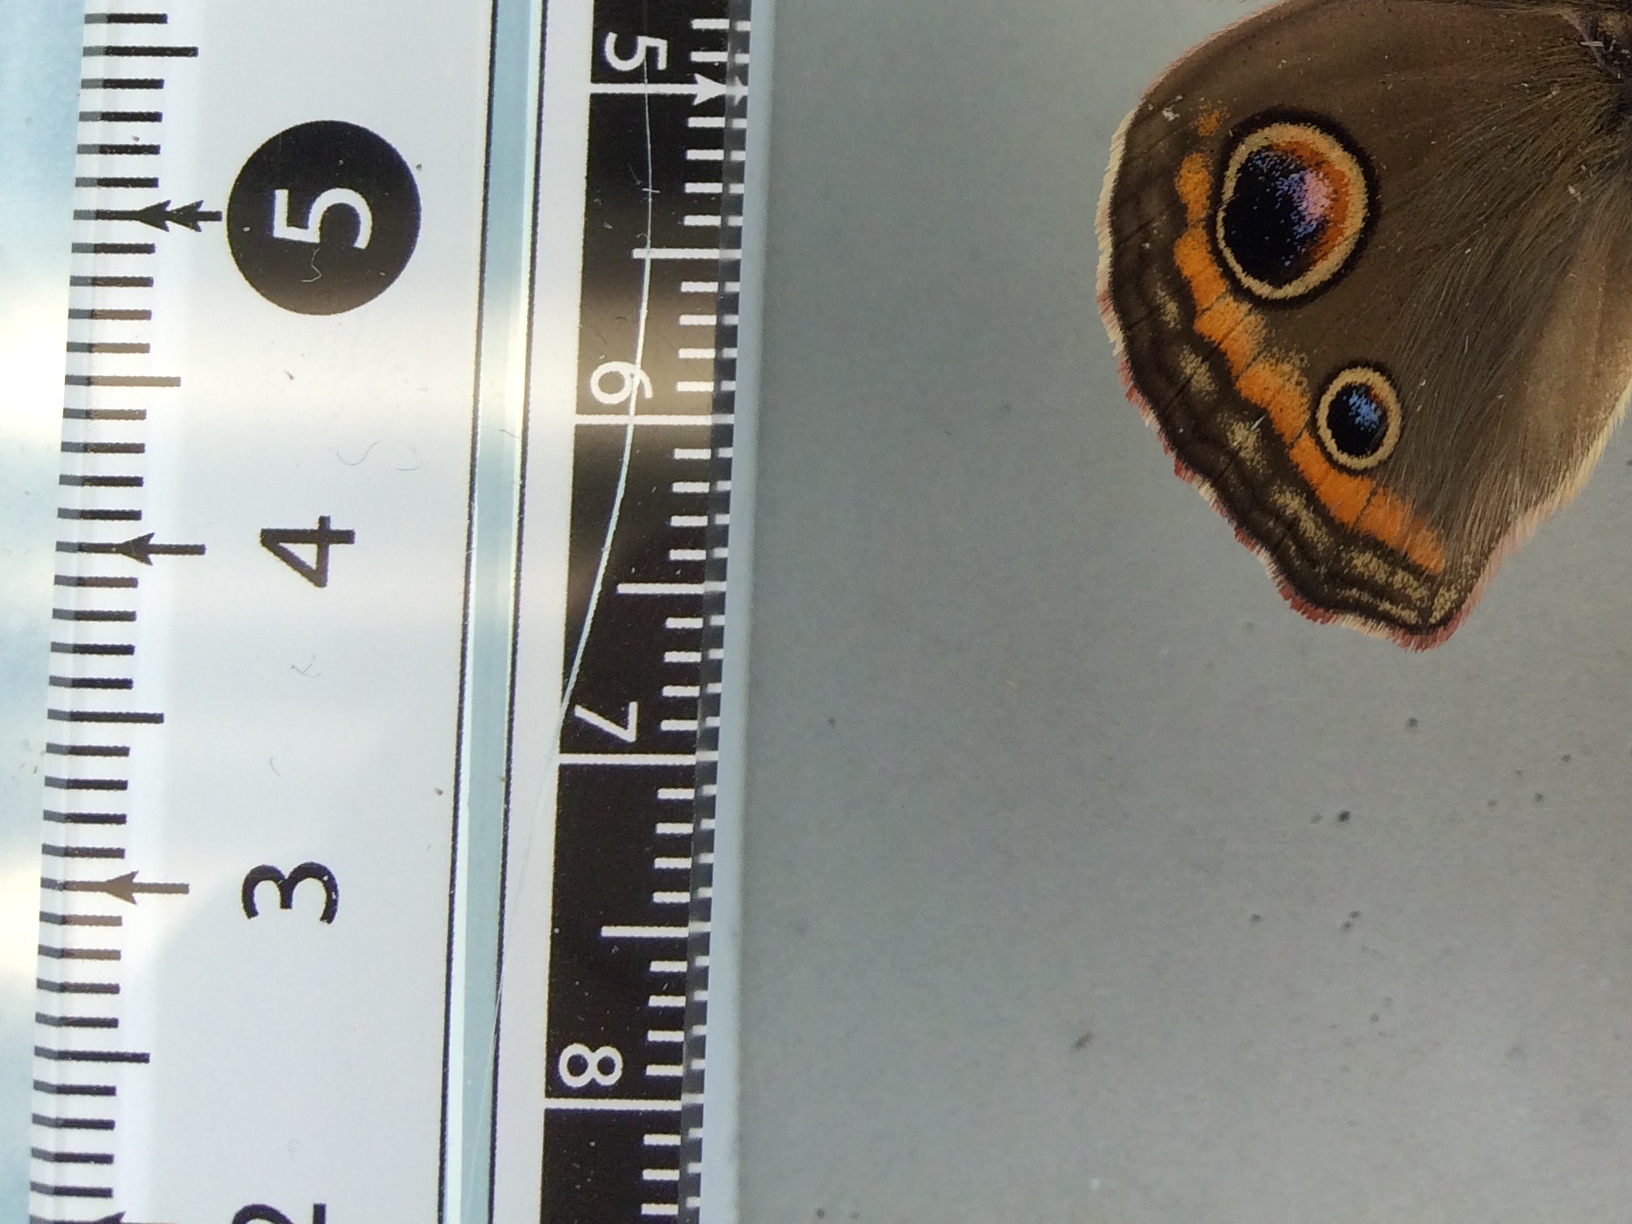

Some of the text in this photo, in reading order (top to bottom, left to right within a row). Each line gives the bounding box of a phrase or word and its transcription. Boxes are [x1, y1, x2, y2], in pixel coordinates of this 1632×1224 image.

[605, 32, 668, 72] 5
[274, 188, 373, 250] 5
[590, 361, 654, 406] 6
[260, 516, 356, 589] 4
[575, 702, 638, 743] 7
[242, 862, 340, 925] 3
[559, 1043, 624, 1089] 8
